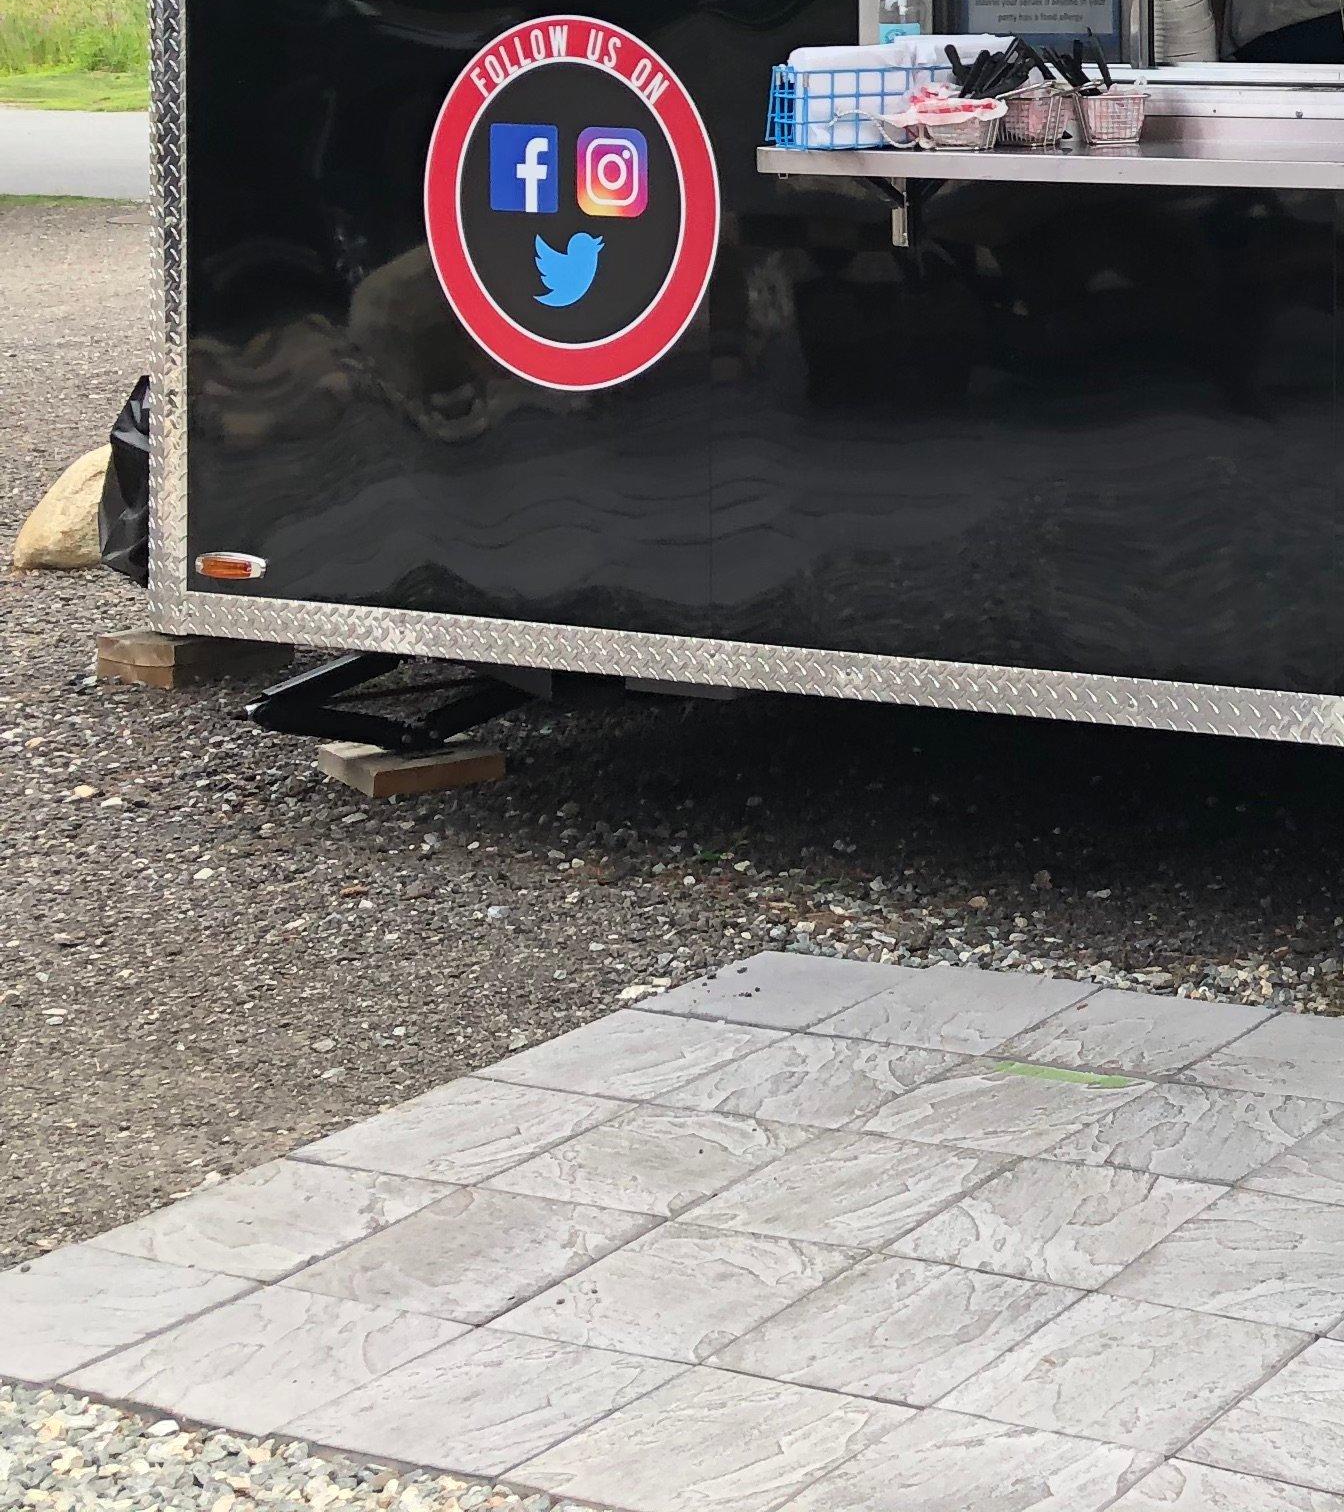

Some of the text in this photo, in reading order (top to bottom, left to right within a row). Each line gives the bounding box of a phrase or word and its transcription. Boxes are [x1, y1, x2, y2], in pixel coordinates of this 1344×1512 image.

[469, 24, 670, 105] FOLLOW US ON
